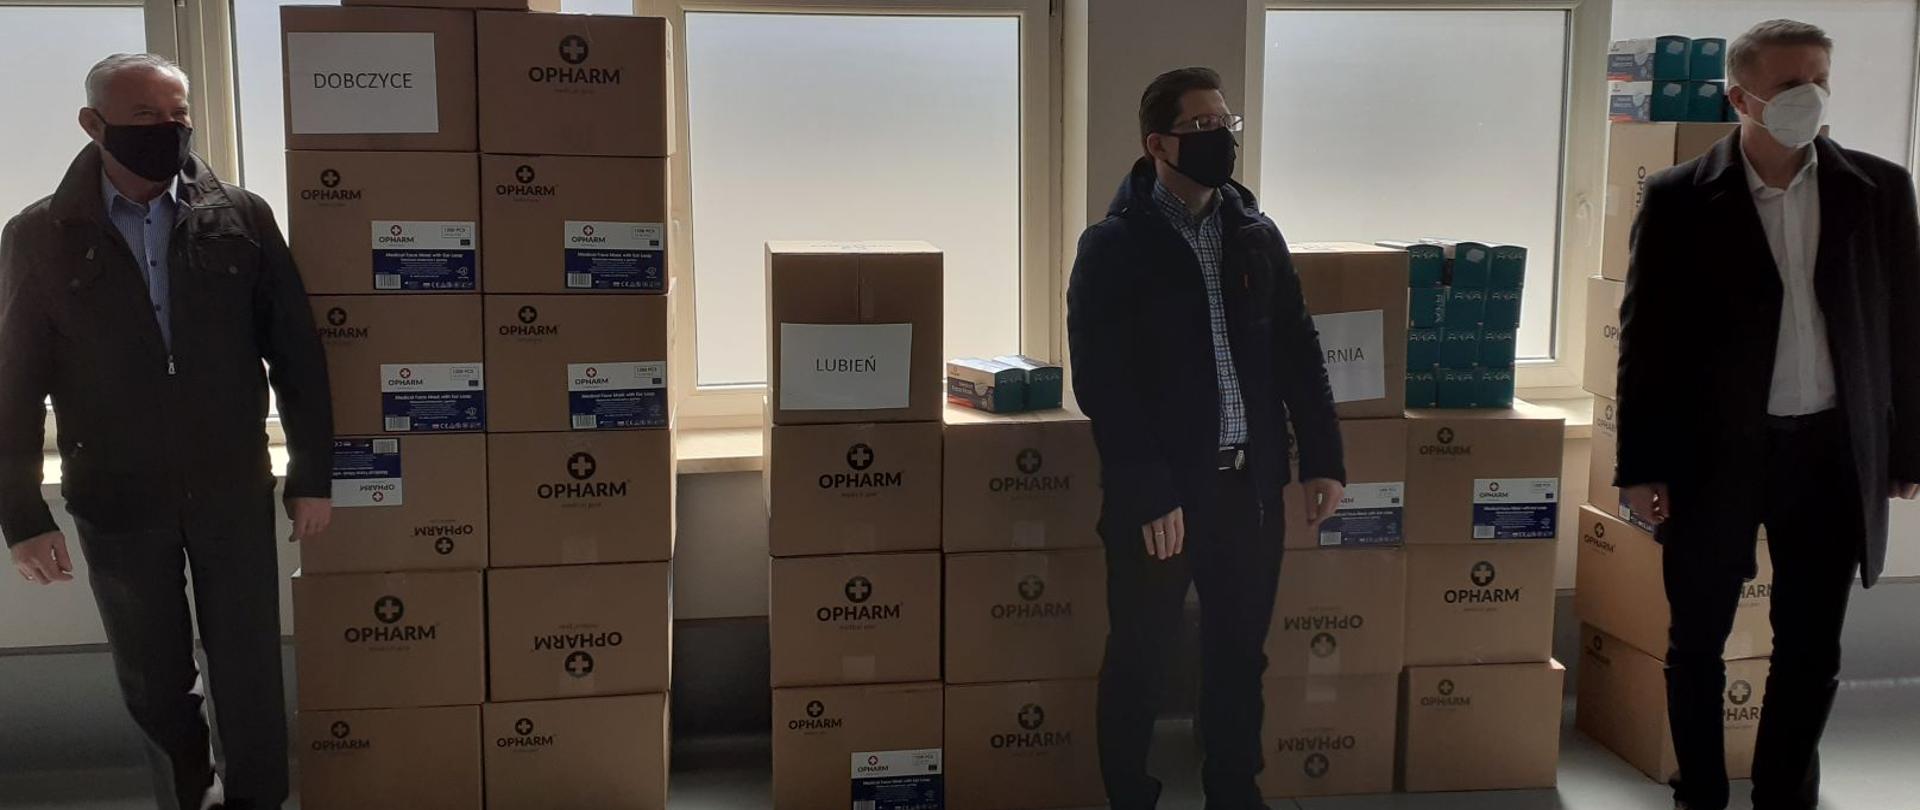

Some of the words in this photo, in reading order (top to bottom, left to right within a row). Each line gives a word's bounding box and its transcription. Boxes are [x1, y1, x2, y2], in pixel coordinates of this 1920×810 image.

[314, 72, 413, 89] DOBCZYCE
[528, 66, 621, 84] OPHARM
[301, 189, 362, 200] OPHARM
[496, 184, 556, 196] OPHARM
[499, 325, 557, 336] OPHARM
[816, 355, 876, 372] LUBIEŃ
[1327, 348, 1365, 364] RNIA
[1419, 445, 1471, 455] OPHARM
[818, 471, 902, 489] OPHARM
[989, 475, 1070, 492] OPHARM
[537, 482, 627, 499] OPHARM
[414, 525, 473, 536] OPHARM
[1444, 588, 1520, 603] OPHARM
[817, 604, 900, 622] OPHARM
[990, 602, 1072, 619] OPHARM
[1283, 614, 1364, 631] OPHARM
[344, 625, 436, 643] OPHARM
[534, 631, 623, 650] OPHARM
[1420, 696, 1471, 706] OPHARM
[1726, 706, 1761, 721] HAR
[789, 718, 843, 729] OPHARM
[311, 740, 370, 751] OPHARM
[497, 736, 553, 748] OPHARM
[990, 731, 1071, 748] OPHARM
[1278, 735, 1355, 752] OPHARM
